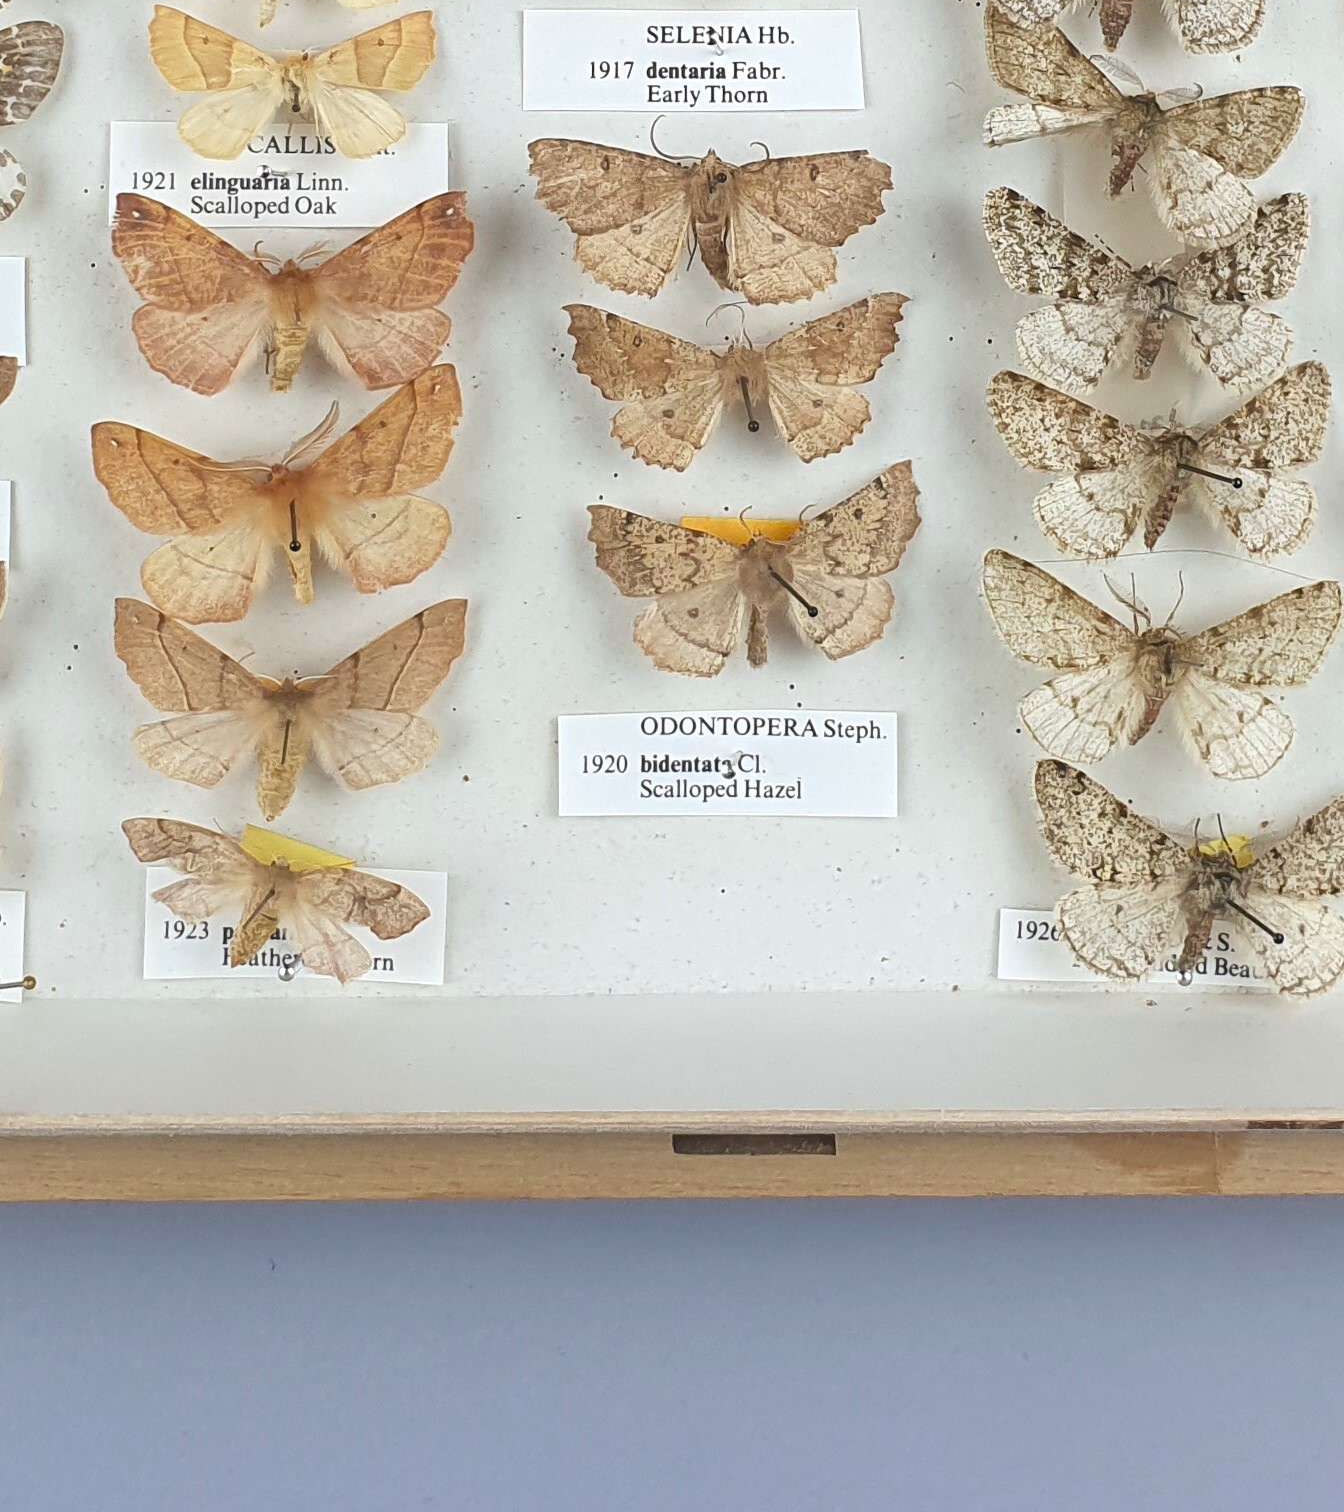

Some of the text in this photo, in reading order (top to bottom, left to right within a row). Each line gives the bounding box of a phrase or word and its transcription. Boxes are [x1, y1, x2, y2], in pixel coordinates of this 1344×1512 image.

[647, 25, 795, 45] SELENIA Hb.
[589, 60, 786, 80] 1917 dentaria Fabr.
[647, 85, 768, 108] Early Thorn
[131, 171, 349, 195] 1921 elinguaria Linn.
[191, 195, 337, 219] Scalloped Oak
[640, 717, 887, 744] ODONTOPERA Steph.
[582, 754, 628, 774] 1920
[737, 753, 767, 774] Cl.
[639, 776, 802, 802] Scalloped Hazel
[163, 920, 209, 940] 1923
